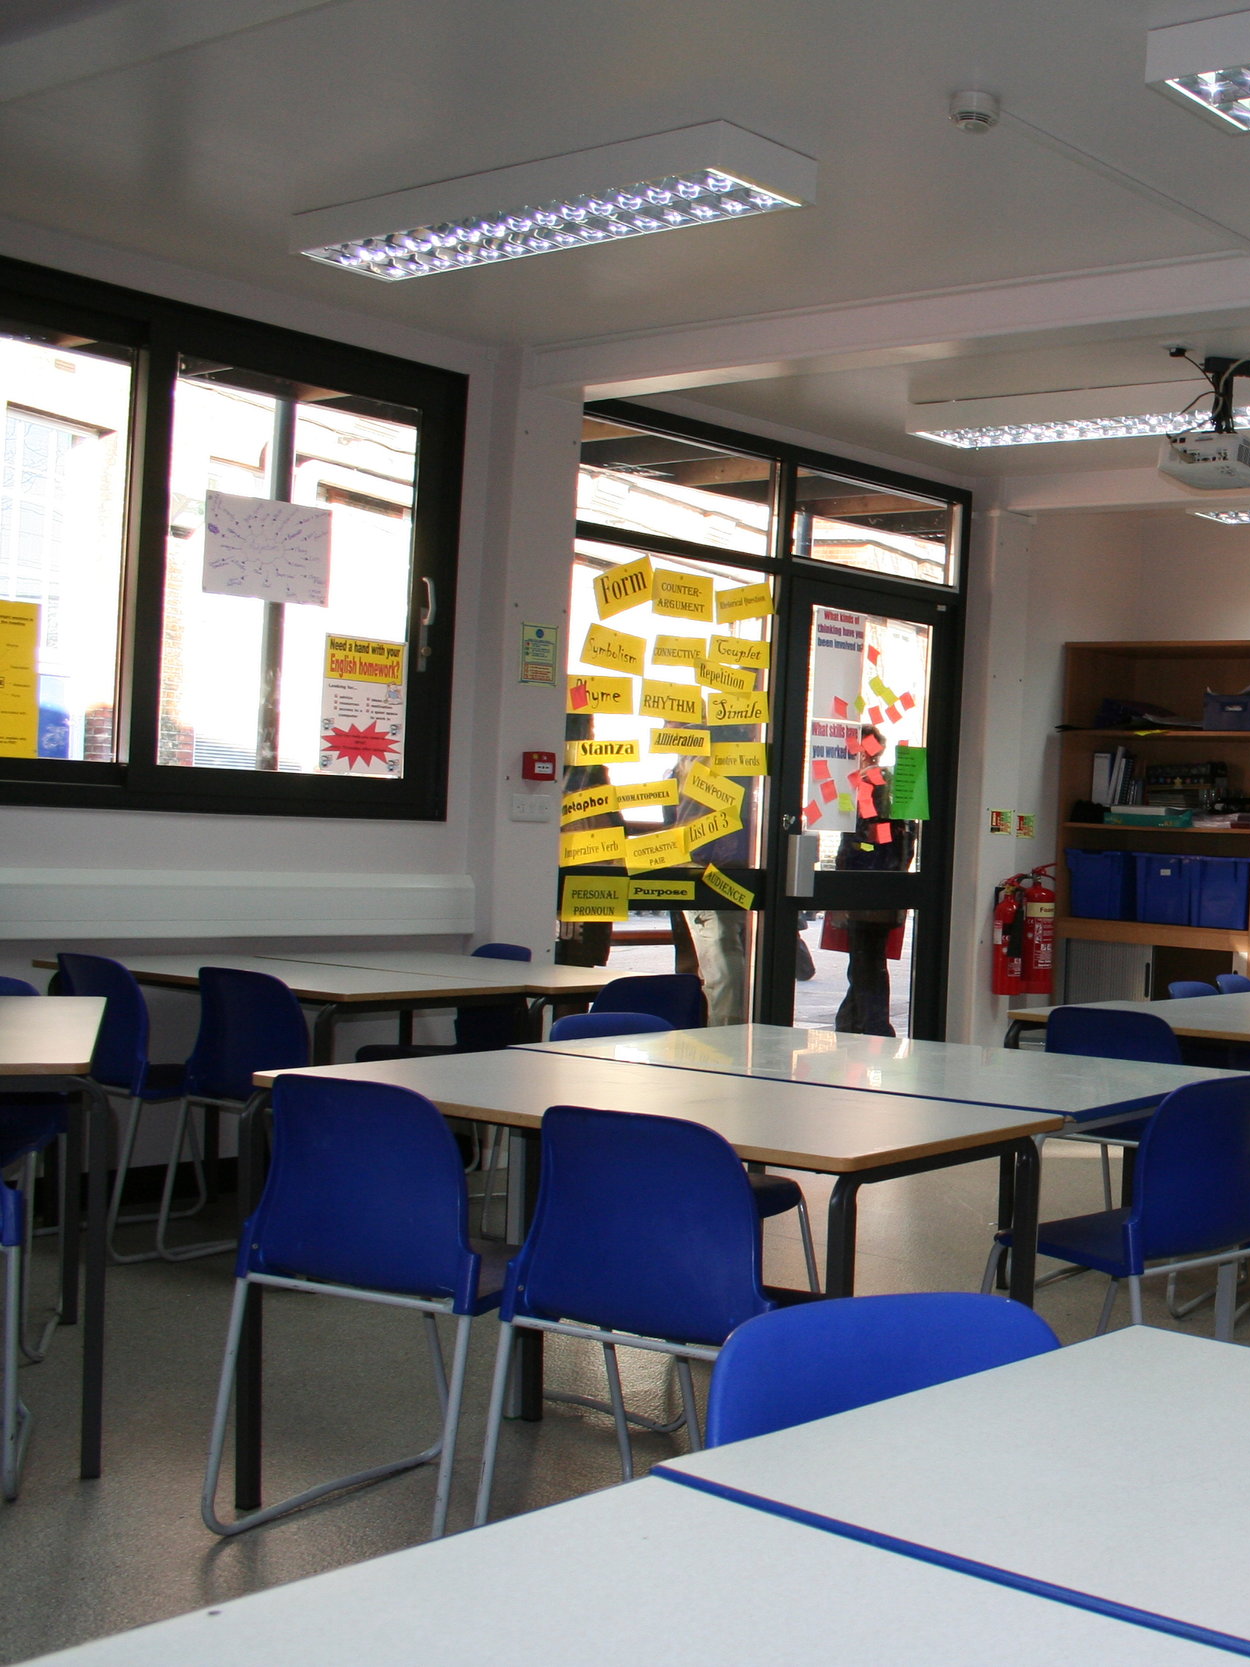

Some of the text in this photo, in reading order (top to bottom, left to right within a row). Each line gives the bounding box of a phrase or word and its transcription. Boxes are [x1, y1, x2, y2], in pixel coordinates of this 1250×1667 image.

[600, 570, 648, 604] Form
[661, 582, 702, 597] COUNTER-
[657, 598, 704, 614] ARGUMENT
[824, 610, 839, 621] What
[817, 623, 842, 636] thinking
[843, 627, 855, 637] have
[330, 638, 400, 659] Need a hand with your
[589, 637, 637, 665] Symbolism
[716, 639, 761, 662] Couplet
[817, 637, 834, 648] been
[834, 639, 856, 651] involved
[654, 646, 701, 660] CONNECTIVE
[330, 652, 400, 680] English homework?
[700, 662, 745, 690] Repetition
[644, 695, 695, 713] RHYTHM
[713, 698, 762, 720] Simile
[812, 721, 828, 737] What
[654, 732, 704, 747] Alliteration
[580, 741, 635, 757] Stanza
[738, 754, 760, 767] Words
[692, 776, 736, 807] VIEWPOINT
[562, 796, 609, 816] Metaphor
[689, 811, 730, 842] List of 3
[564, 839, 619, 859] Imperative Verb
[633, 841, 677, 857] CONTRASTIVE
[571, 889, 619, 900] PERSONAL
[633, 886, 688, 898] Purpose
[706, 871, 746, 904] AUDIENCE
[573, 906, 615, 916] PRONOUN
